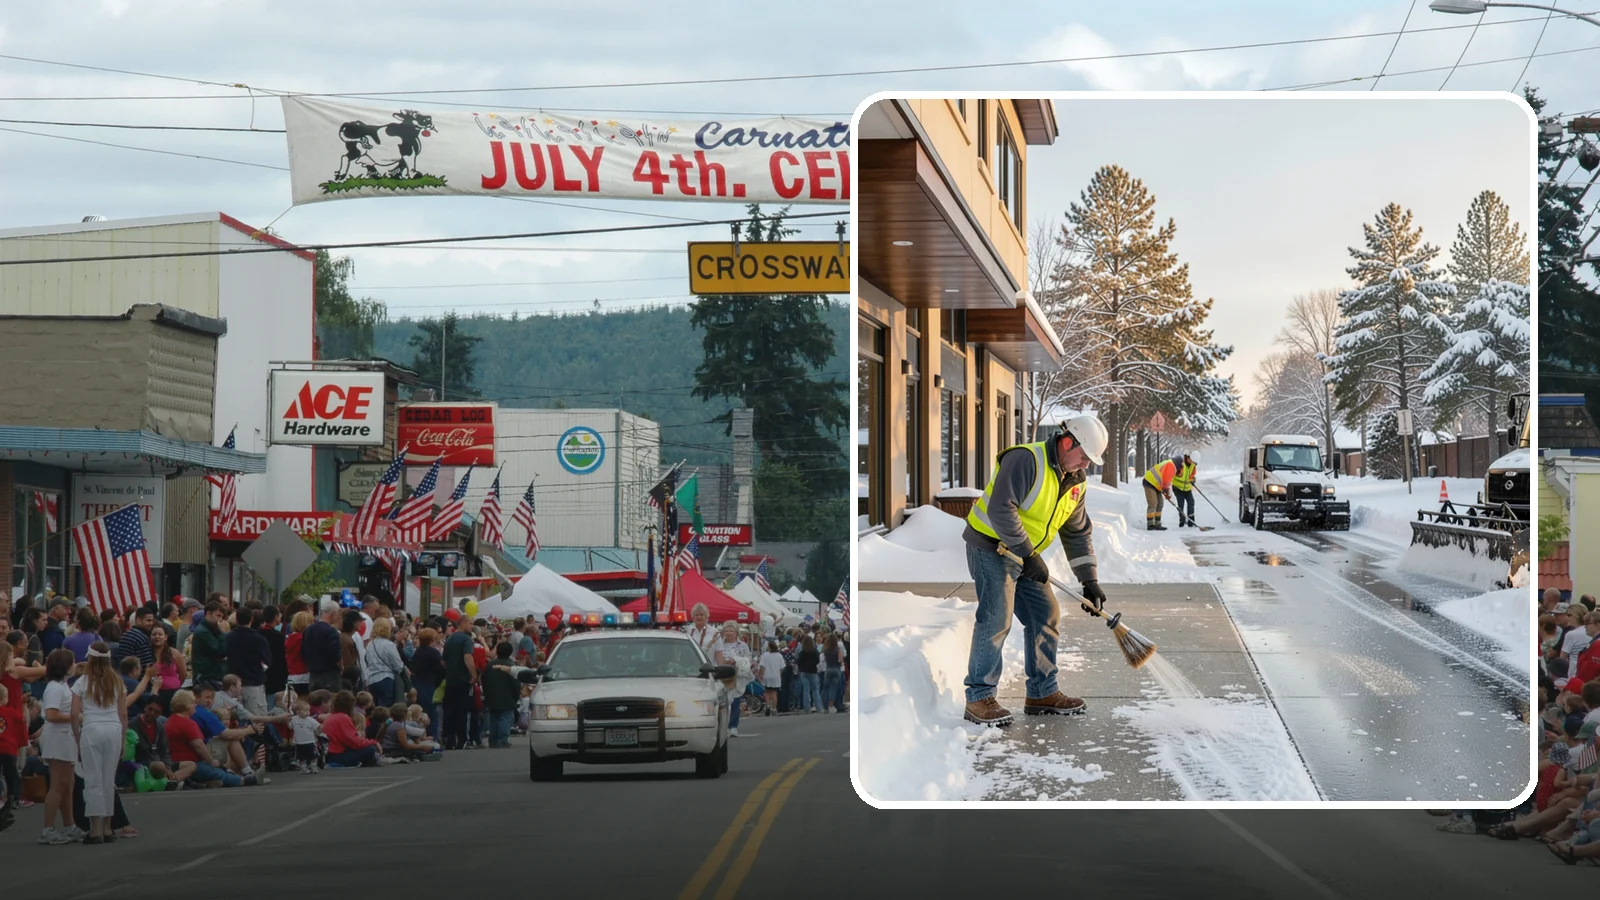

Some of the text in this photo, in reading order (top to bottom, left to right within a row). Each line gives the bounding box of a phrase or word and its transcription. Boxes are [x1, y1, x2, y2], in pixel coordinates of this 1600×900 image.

[694, 121, 850, 150] Carnat
[481, 140, 605, 192] JULY
[631, 150, 747, 198] 4th.
[697, 254, 850, 280] CROSSWA
[282, 380, 373, 420] ACE
[405, 409, 485, 422] CEDAR LOG
[283, 421, 371, 437] Hardware
[416, 428, 477, 447] Coca-Cola
[353, 467, 385, 480] Simpl
[83, 485, 155, 495] St. Vincent de Paul
[81, 503, 154, 522] THT
[212, 516, 330, 536] HARDARE
[688, 526, 742, 535] CRNATION
[699, 535, 730, 544] GLASS
